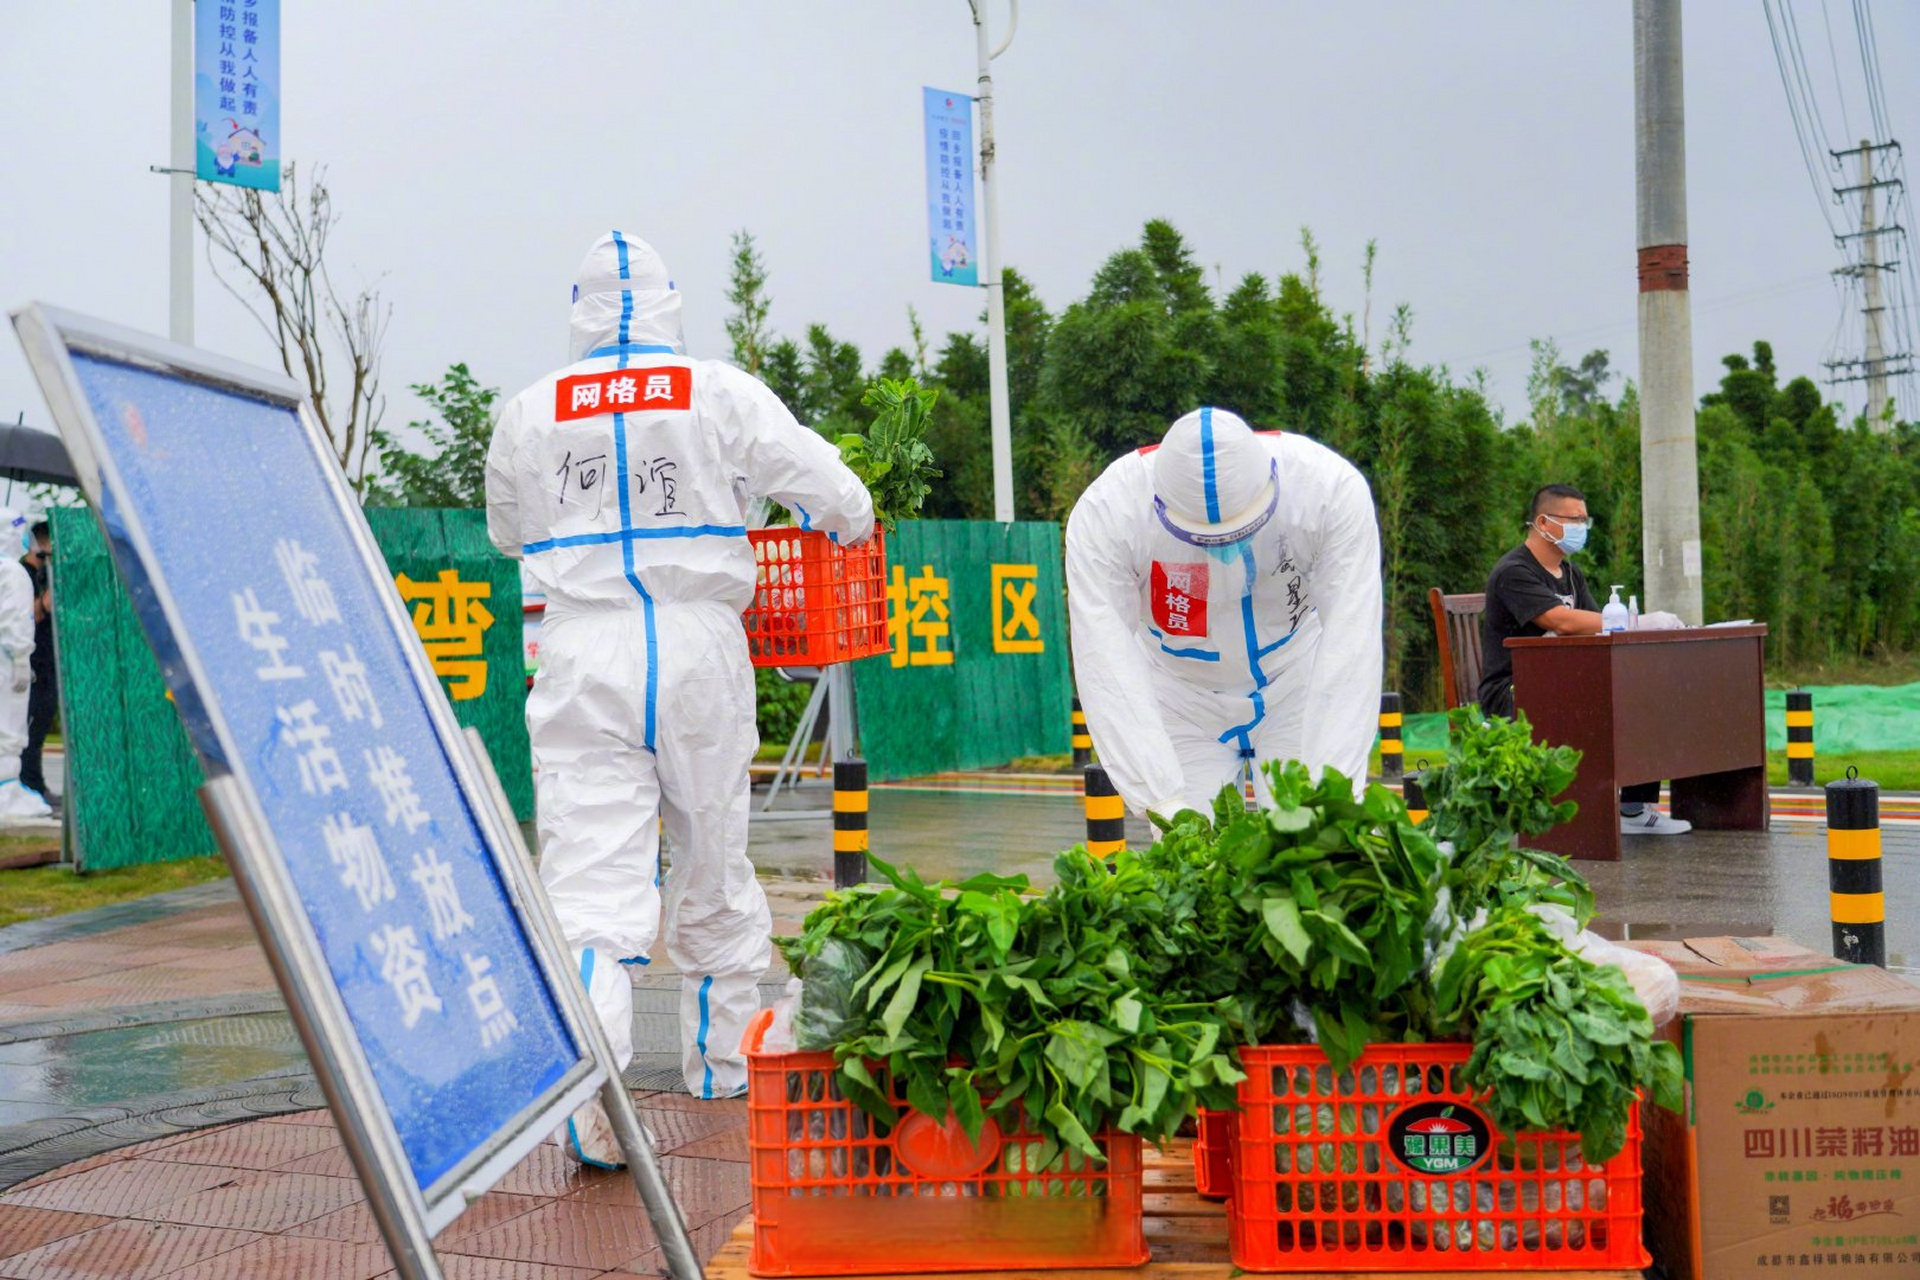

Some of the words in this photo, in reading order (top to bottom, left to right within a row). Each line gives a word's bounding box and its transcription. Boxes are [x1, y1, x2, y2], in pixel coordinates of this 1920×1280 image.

[219, 0, 236, 113] 防控从我做起
[571, 374, 674, 412] 网格员
[1165, 570, 1191, 631] 网格员
[232, 586, 442, 1031] 生活物资
[274, 537, 518, 1050] 临时堆放点
[1423, 1158, 1458, 1169] YGM
[1744, 1125, 1919, 1158] 四川菜籽油
